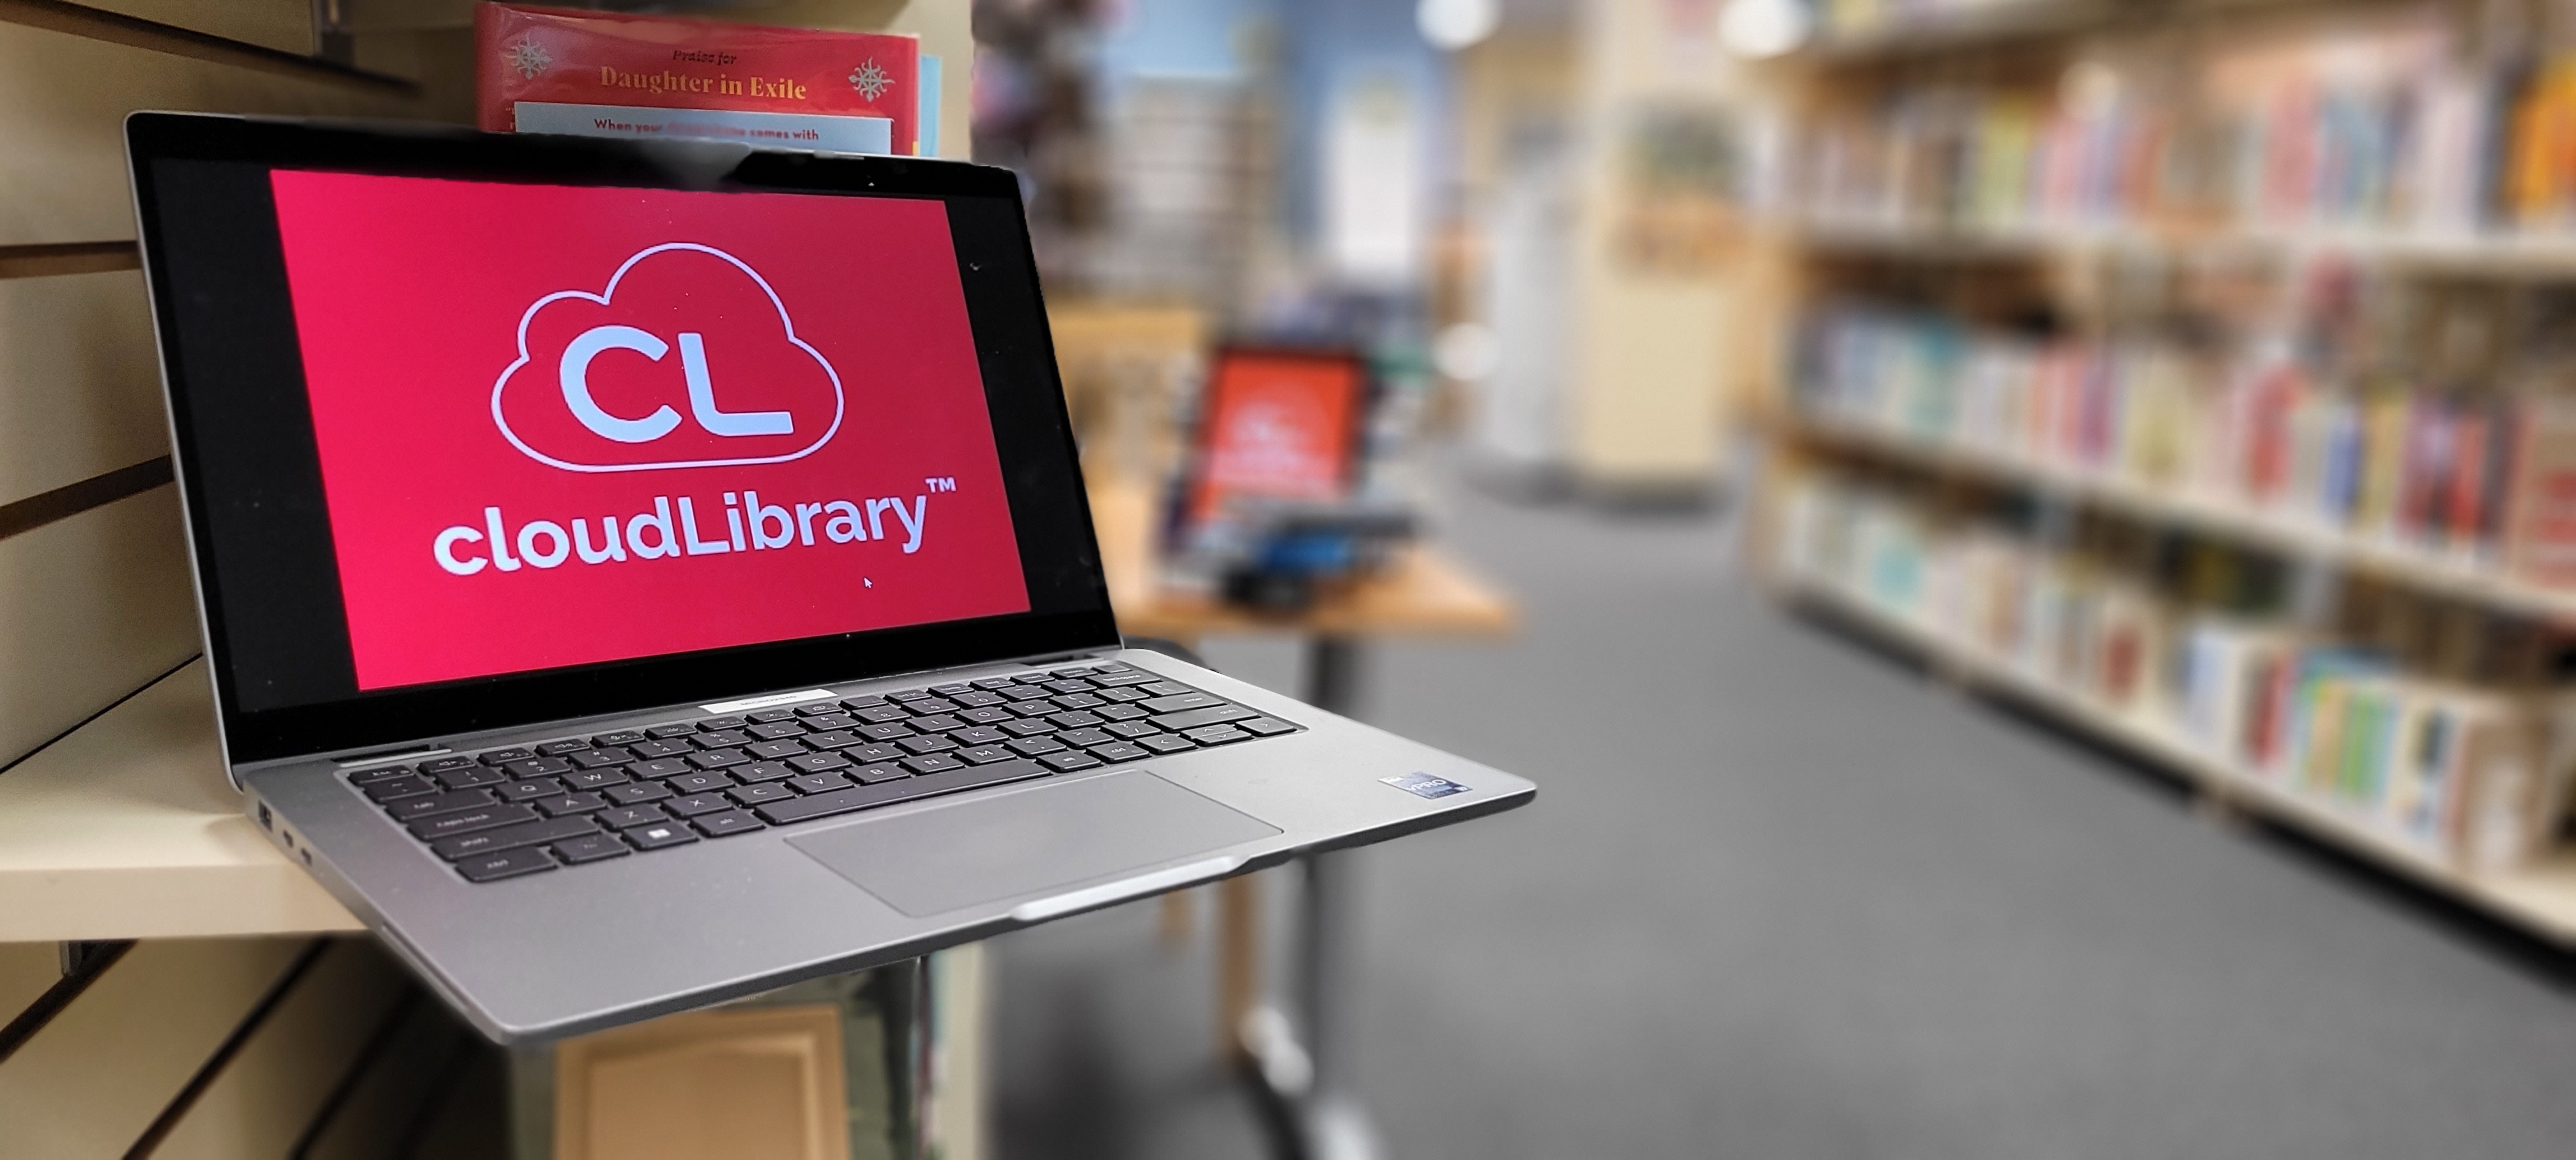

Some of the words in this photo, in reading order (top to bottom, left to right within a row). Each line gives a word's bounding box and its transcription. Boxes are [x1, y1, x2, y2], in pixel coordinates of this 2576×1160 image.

[673, 50, 714, 62] Praise
[717, 52, 737, 65] for
[600, 66, 713, 93] Daughter
[720, 74, 742, 95] in
[750, 77, 806, 99] Exile
[594, 119, 631, 131] When
[636, 123, 663, 133] your
[793, 129, 819, 140] with
[560, 326, 793, 442] CL
[565, 799, 579, 807] A
[624, 811, 638, 820] Z
